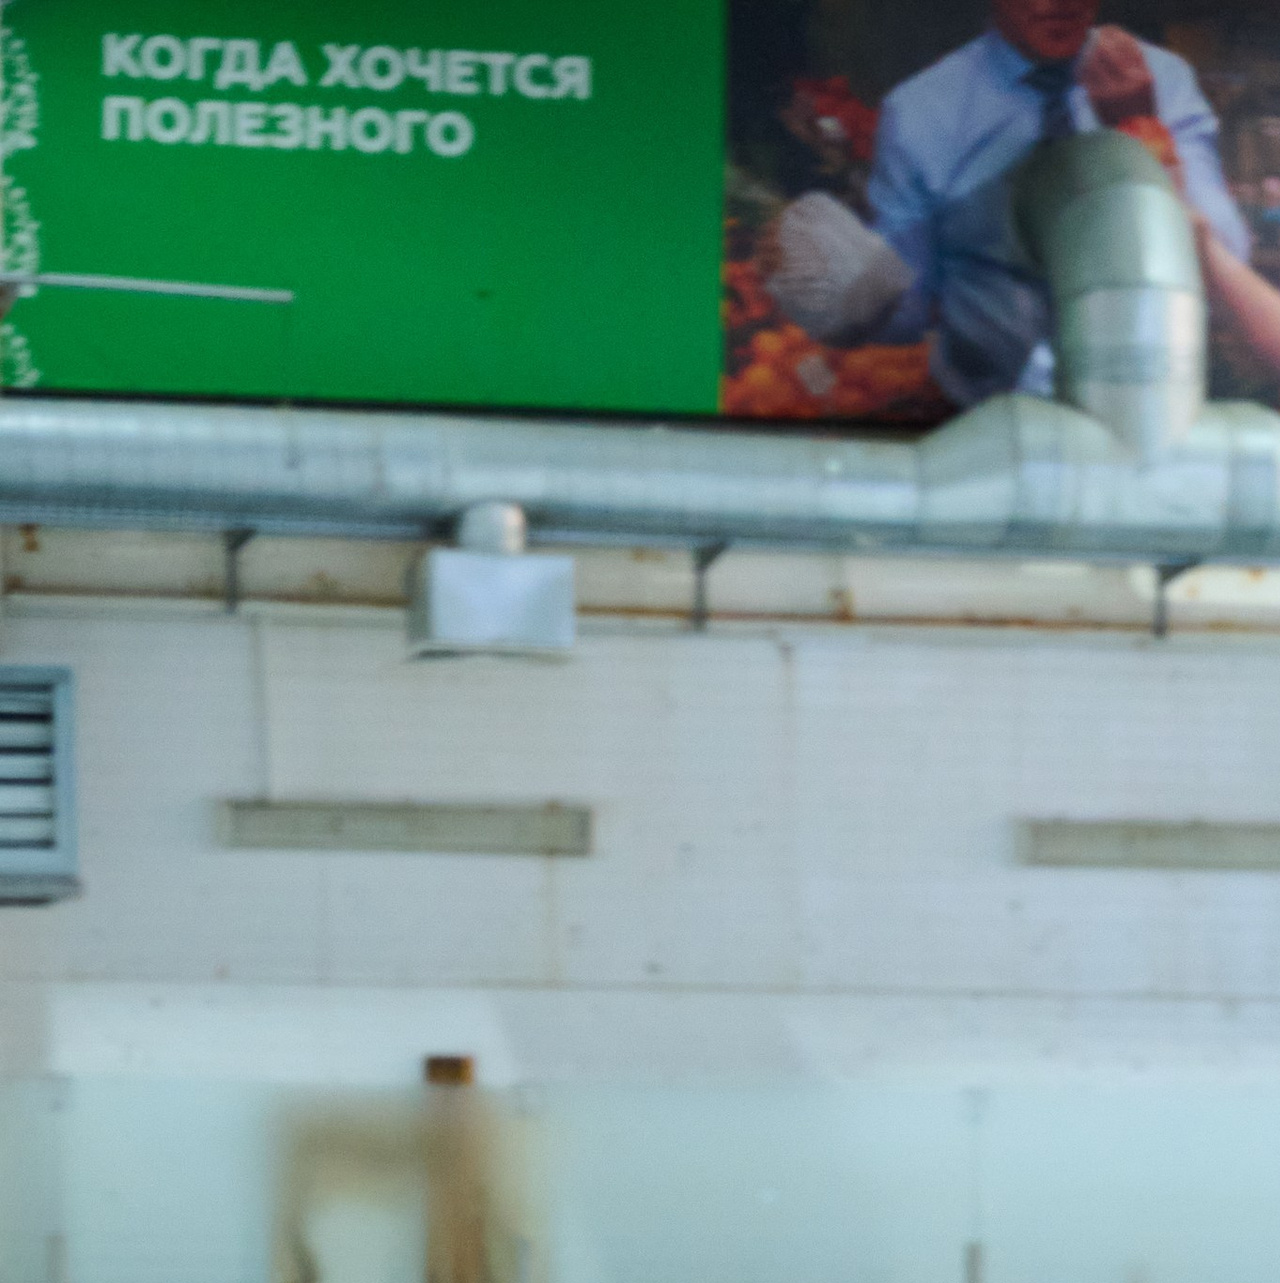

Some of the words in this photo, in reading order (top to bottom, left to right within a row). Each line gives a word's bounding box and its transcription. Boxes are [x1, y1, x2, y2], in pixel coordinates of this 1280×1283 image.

[102, 34, 306, 91] КОГДА
[319, 44, 591, 99] ХОЧЕТСЯ
[102, 97, 474, 156] ПОЛЕЗНОГО
